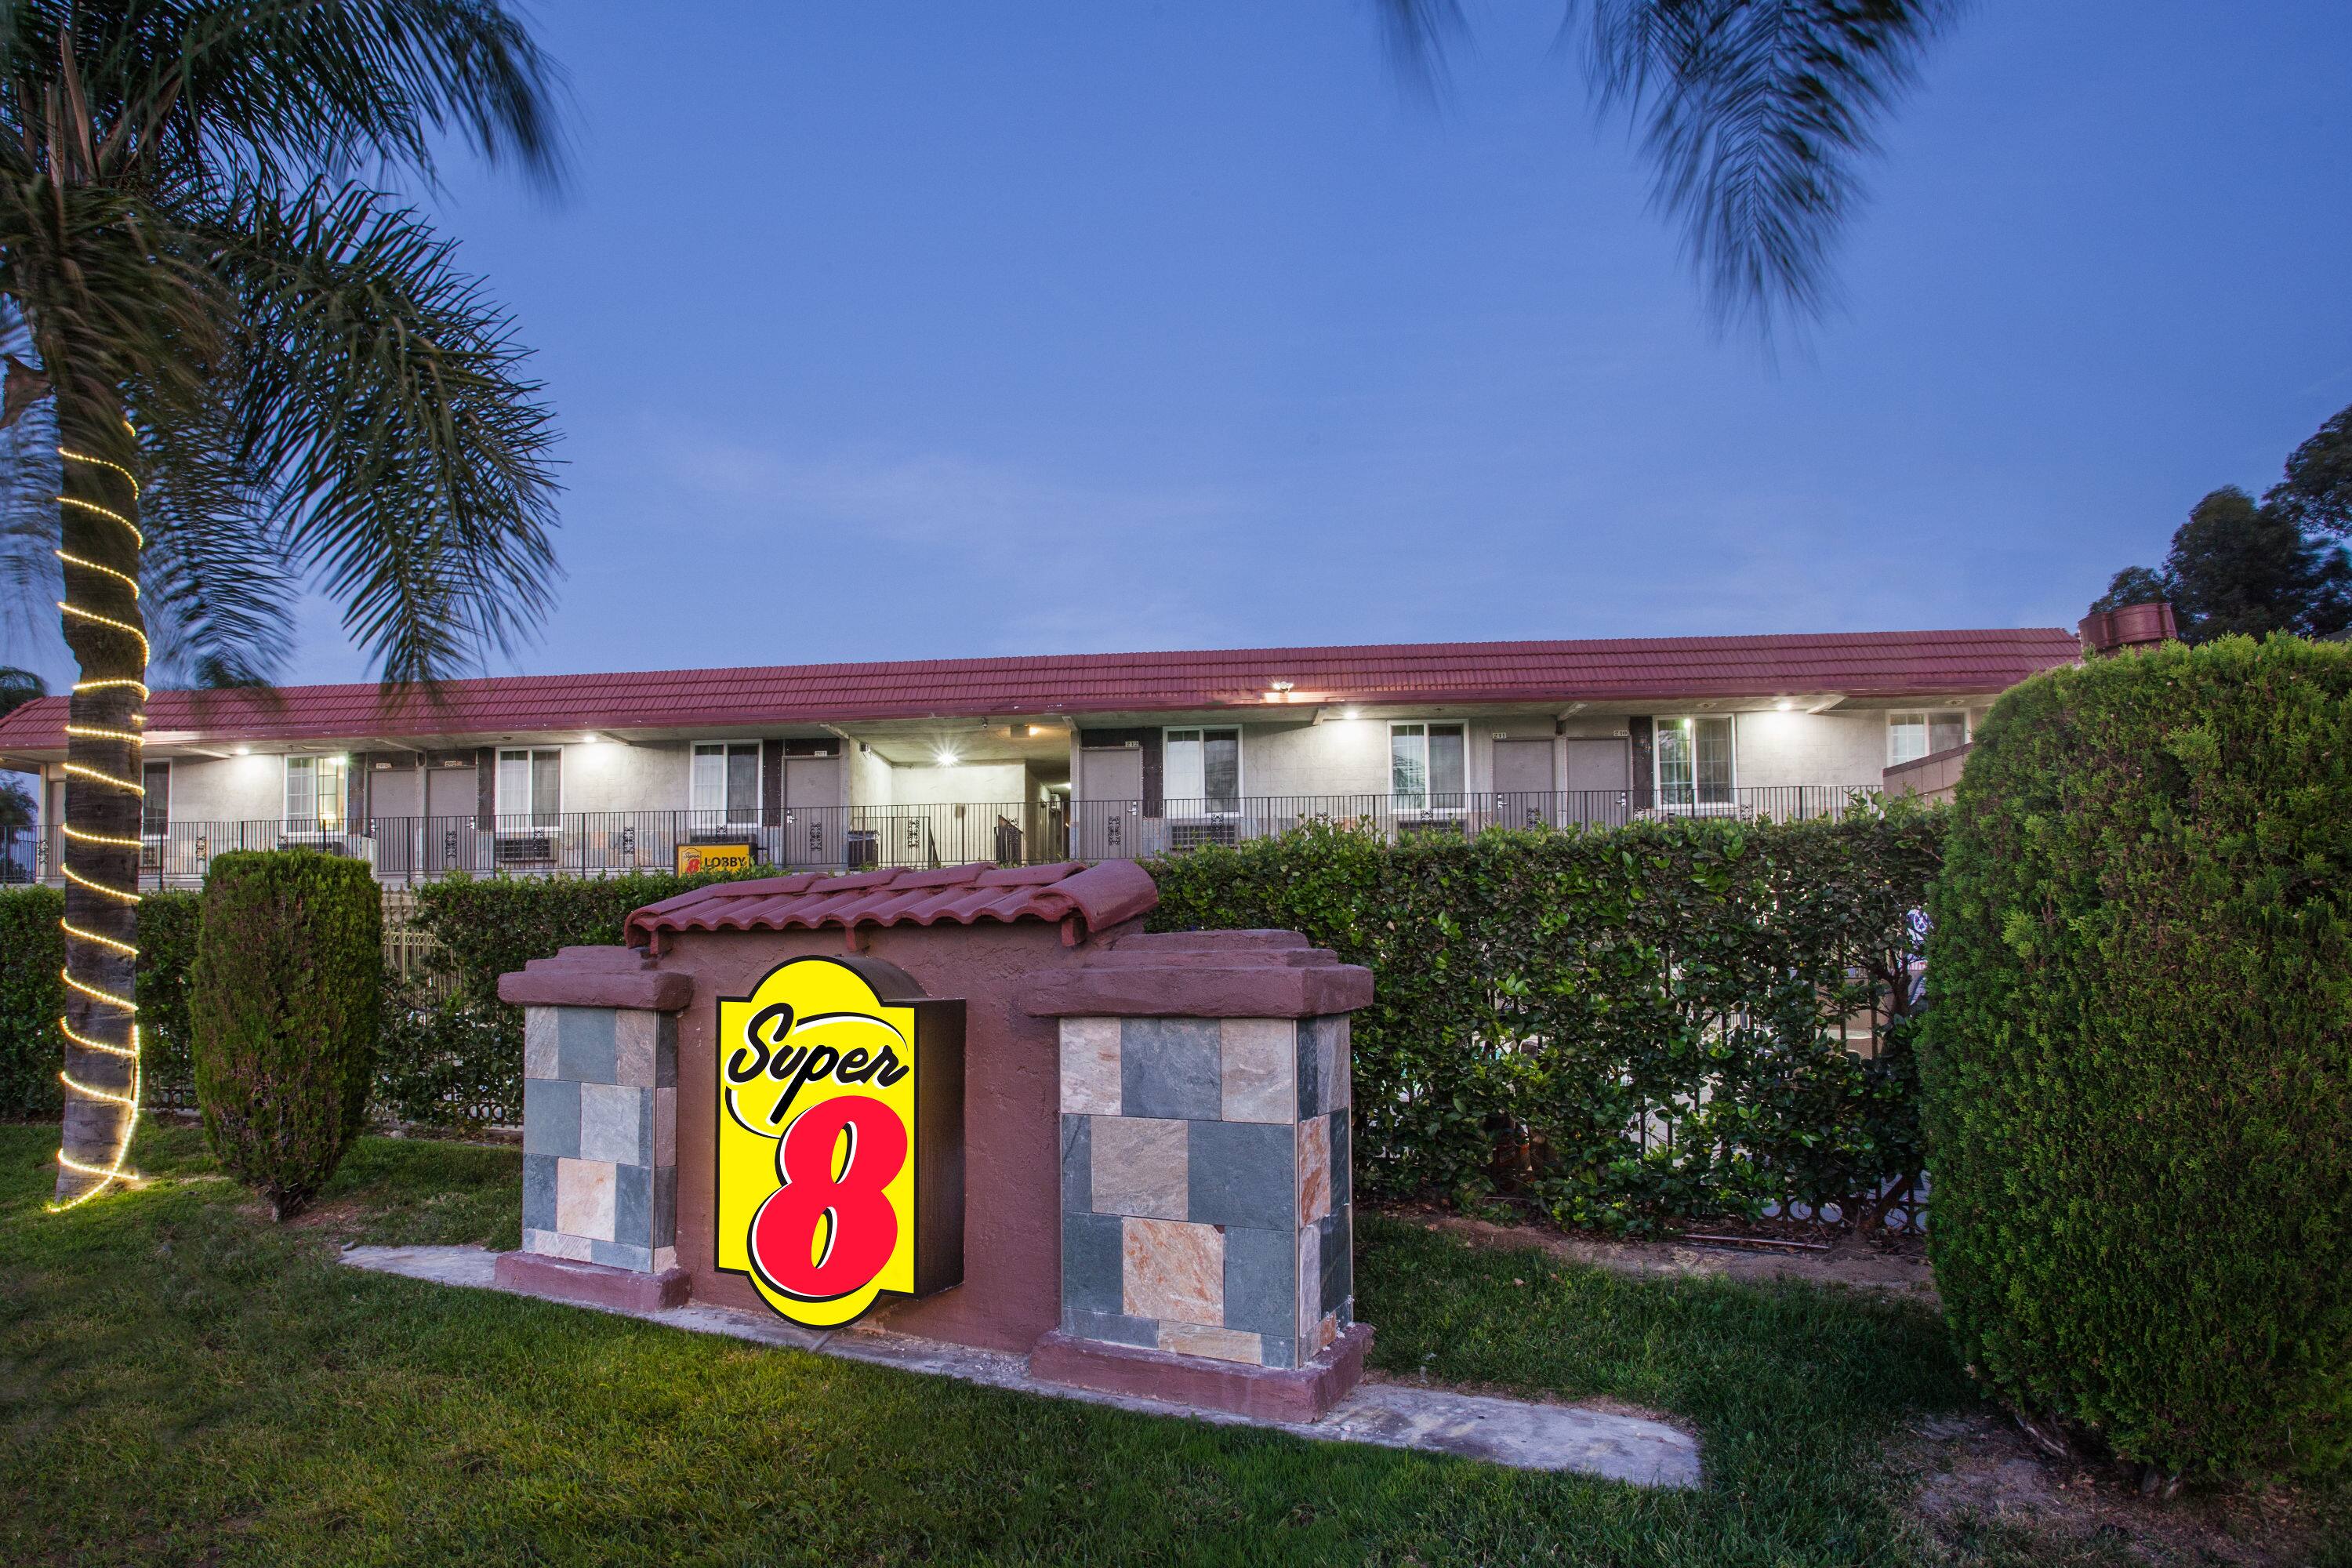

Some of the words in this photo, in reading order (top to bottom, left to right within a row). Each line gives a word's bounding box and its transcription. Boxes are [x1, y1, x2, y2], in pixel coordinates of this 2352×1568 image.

[685, 858, 700, 874] 8
[704, 857, 746, 867] LOBBY
[727, 1002, 910, 1127] Super
[747, 1095, 908, 1303] 8
